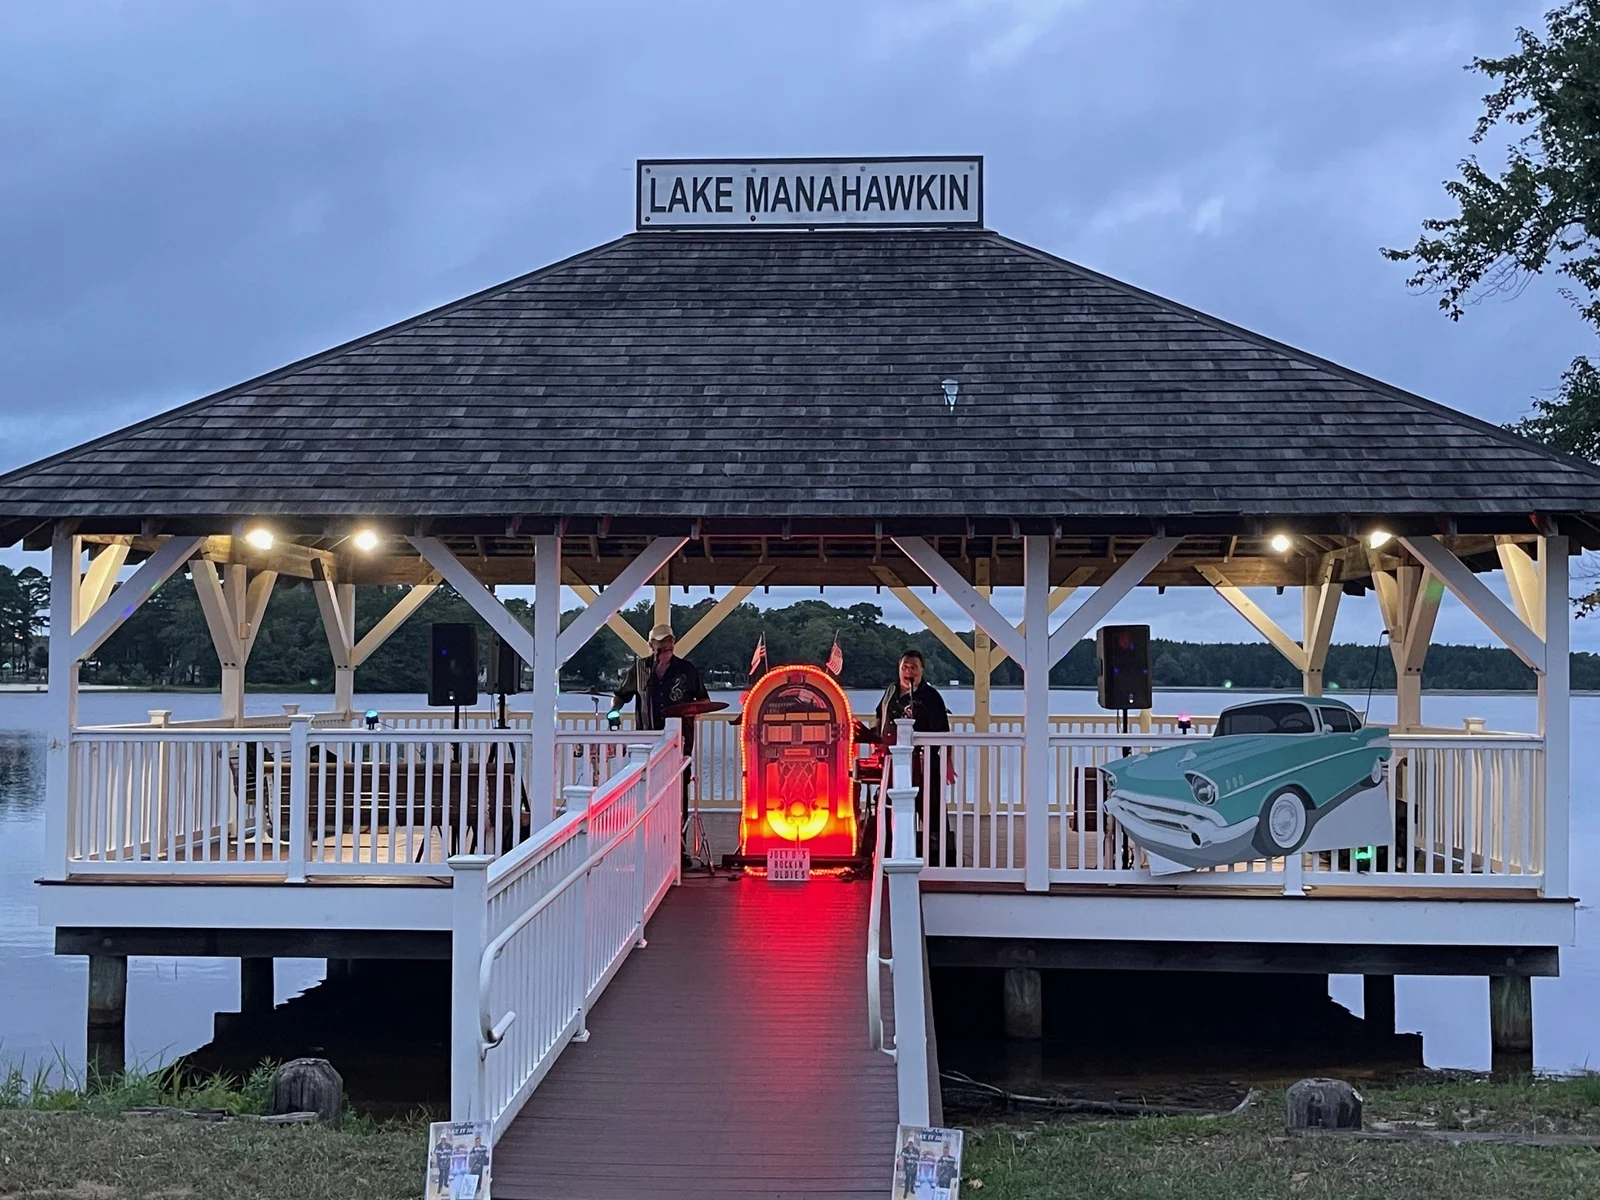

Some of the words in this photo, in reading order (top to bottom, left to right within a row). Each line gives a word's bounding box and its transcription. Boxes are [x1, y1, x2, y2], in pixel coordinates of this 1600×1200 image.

[650, 176, 734, 213] LAKE
[745, 174, 969, 213] MANAHAWKIN
[769, 850, 788, 859] JOEY
[774, 860, 803, 869] ROCKIN
[775, 870, 805, 879] OLDIES
